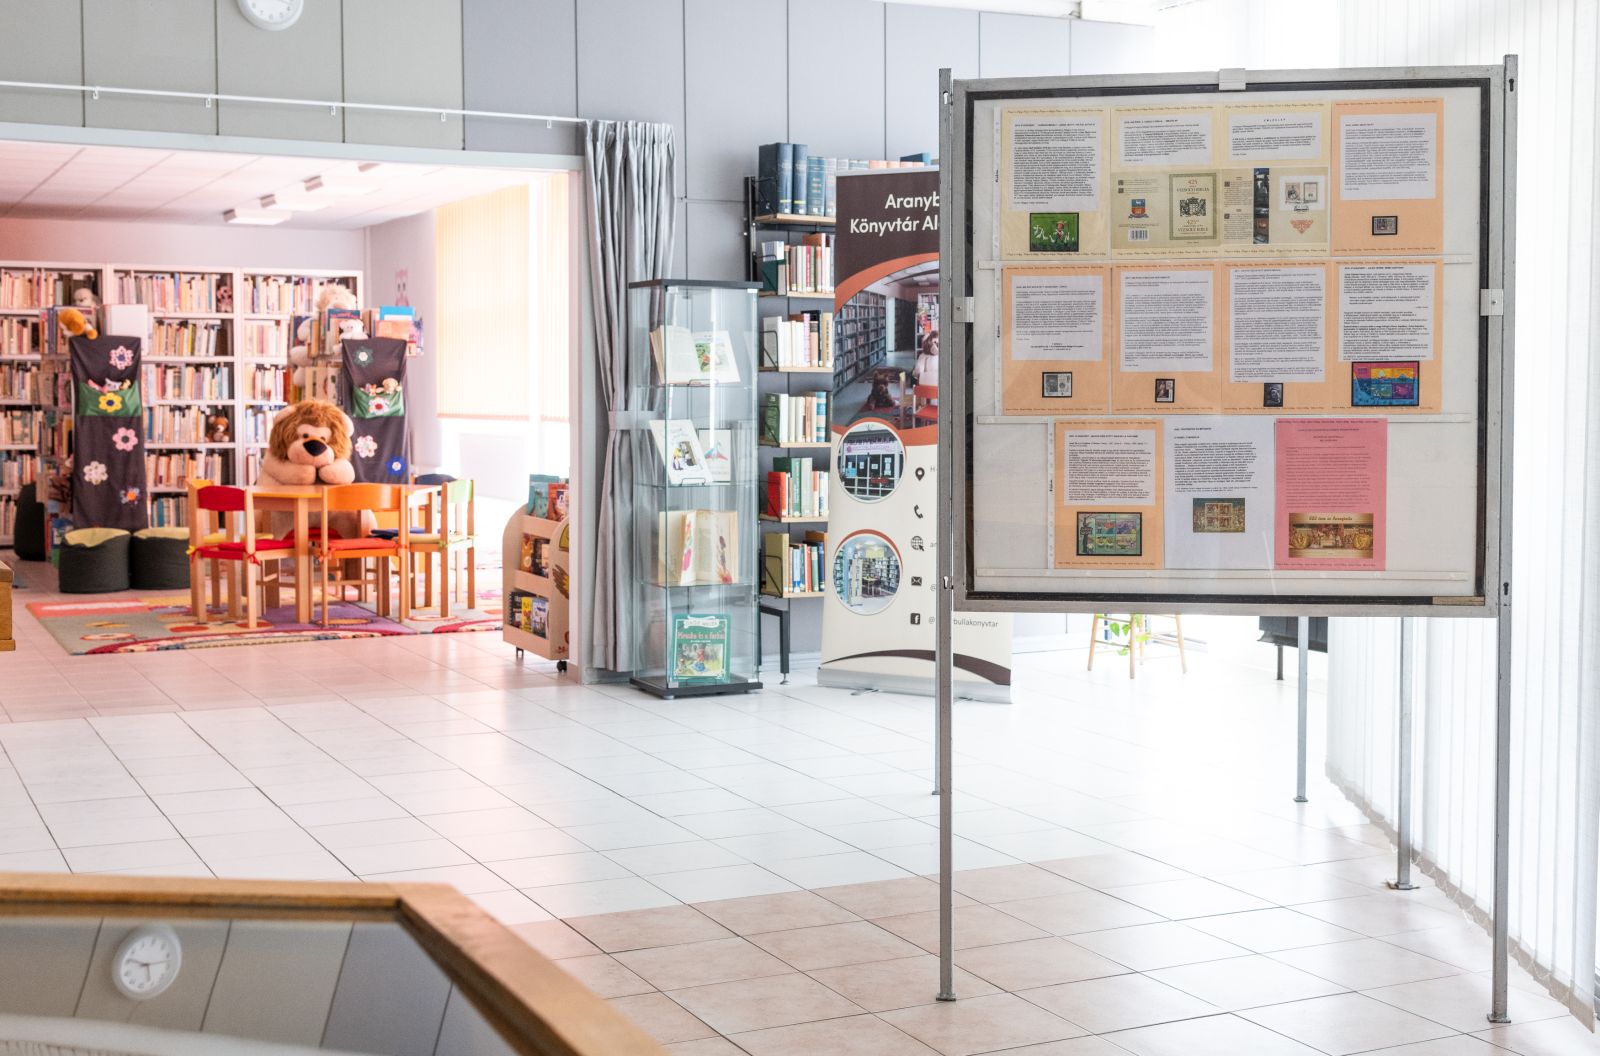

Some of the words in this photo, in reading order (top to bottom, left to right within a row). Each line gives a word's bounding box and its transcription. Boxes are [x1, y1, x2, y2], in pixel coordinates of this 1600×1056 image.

[885, 191, 940, 212] Aranyb
[850, 216, 920, 237] Könyvtár
[922, 214, 940, 231] Al
